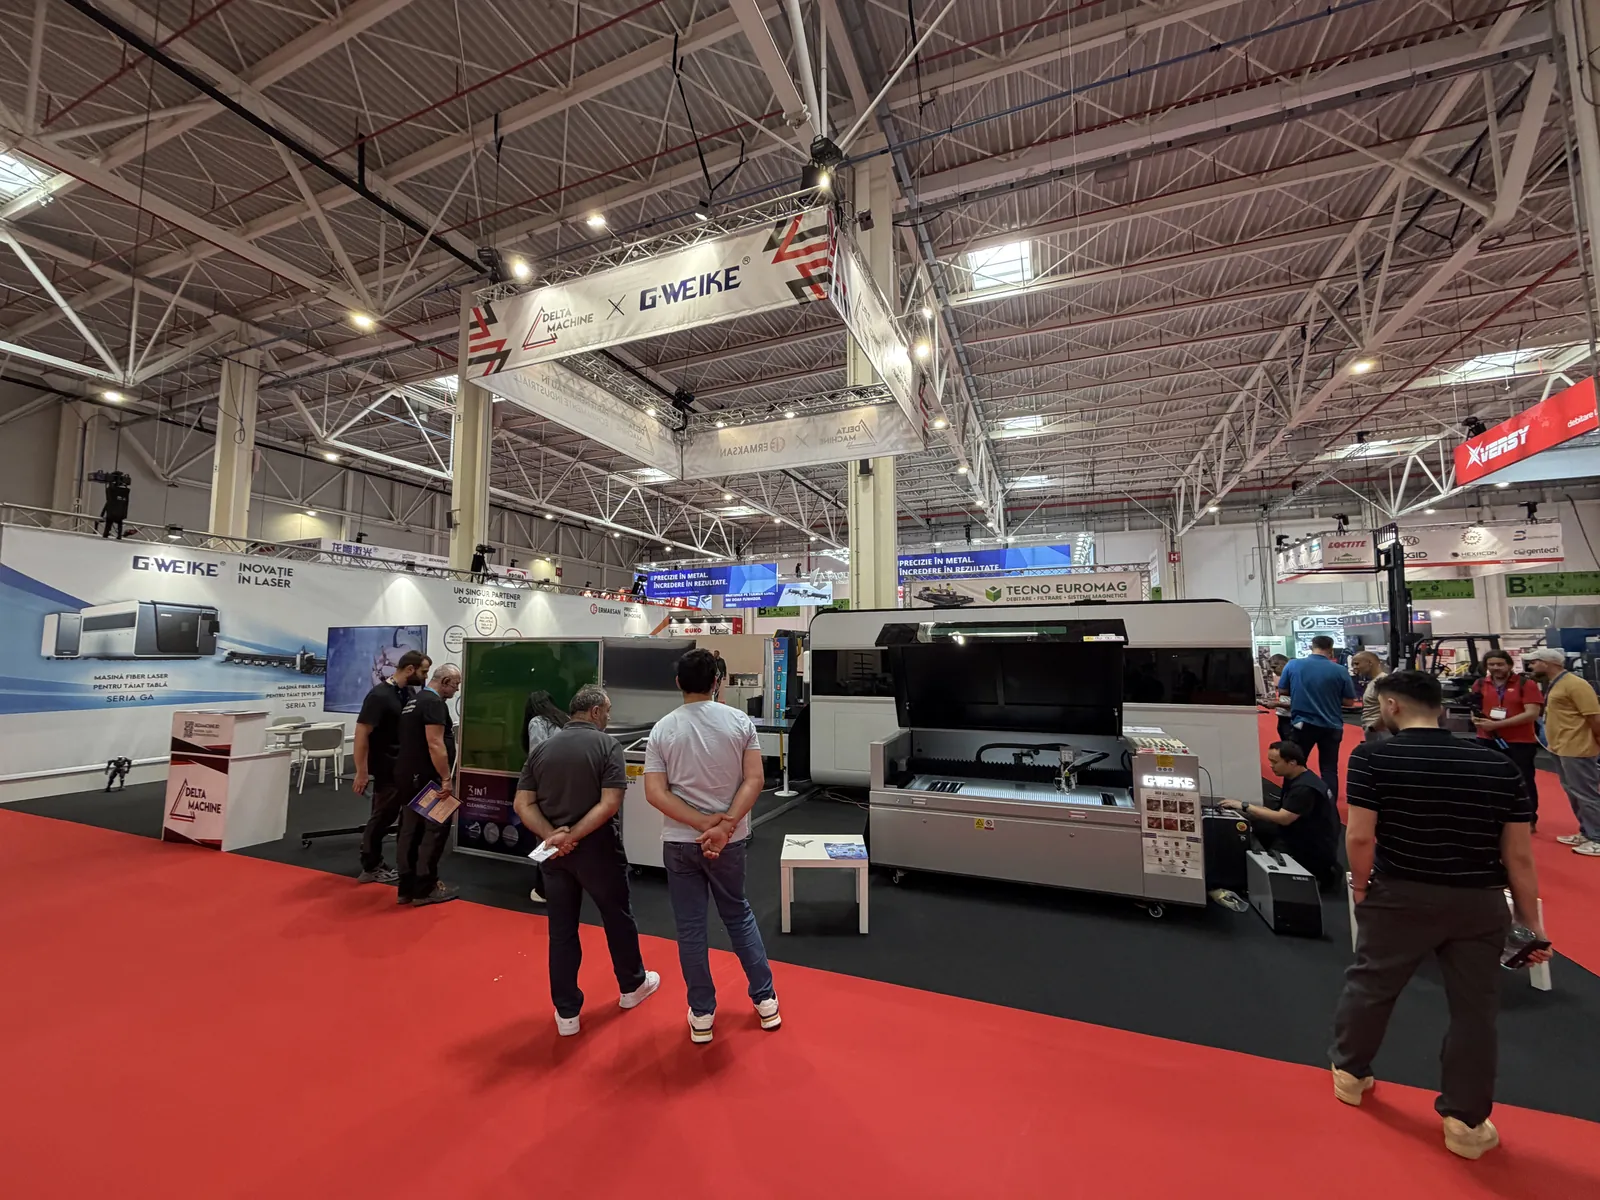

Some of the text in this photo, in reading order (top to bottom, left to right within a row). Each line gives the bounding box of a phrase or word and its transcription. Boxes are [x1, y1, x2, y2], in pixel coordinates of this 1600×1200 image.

[542, 307, 572, 323] DELTA
[547, 313, 594, 334] MACHINE
[1328, 540, 1367, 549] LOCTITE
[1170, 553, 1178, 561] H
[1403, 551, 1428, 559] DGID
[899, 556, 975, 567] PRECIZIE ÎN METAL.
[899, 567, 942, 576] ÎNCREDERE
[943, 565, 953, 573] ÎN
[238, 573, 291, 588] ÎN LASER
[653, 581, 685, 589] ÎNCREDERE
[694, 579, 728, 587] REZULTATE.
[454, 586, 521, 600] UN SINGUR PARTENER
[1006, 581, 1127, 596] TECNO EUROMAG
[485, 599, 517, 608] COMPLETE
[106, 694, 136, 703] SERIA
[185, 787, 206, 799] DELTA
[474, 787, 483, 796] IN
[188, 800, 222, 814] MACHINE
